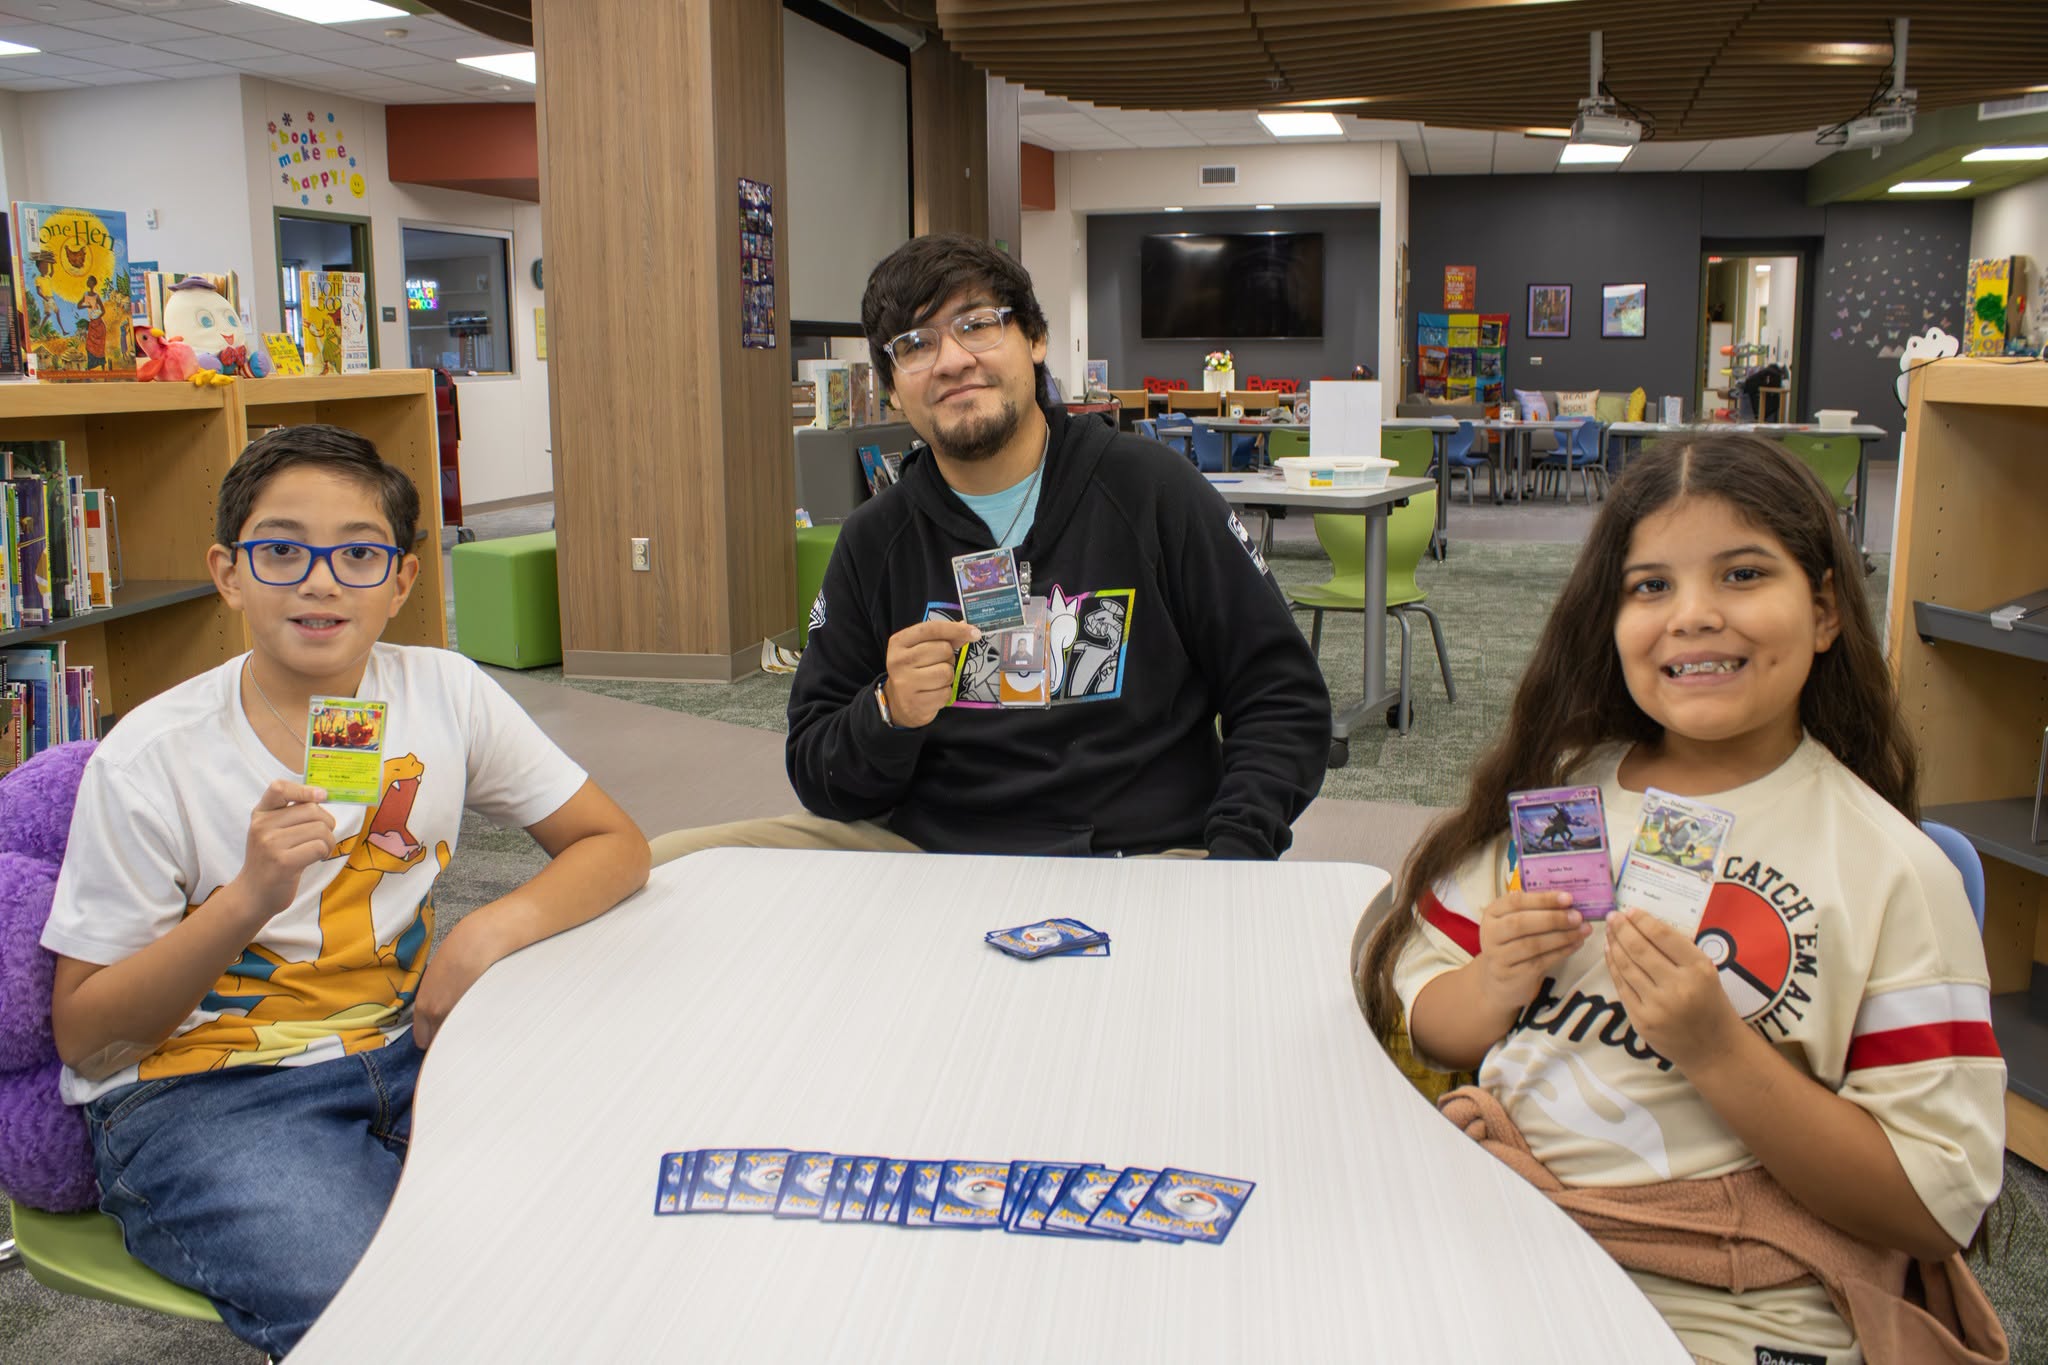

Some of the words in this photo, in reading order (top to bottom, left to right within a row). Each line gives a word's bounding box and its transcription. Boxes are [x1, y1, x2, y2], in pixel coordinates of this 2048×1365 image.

[279, 129, 327, 145] books
[278, 145, 321, 168] make
[326, 145, 346, 160] me
[290, 168, 346, 192] happy!
[73, 220, 115, 251] Hen
[1723, 856, 1815, 922] CATCH
